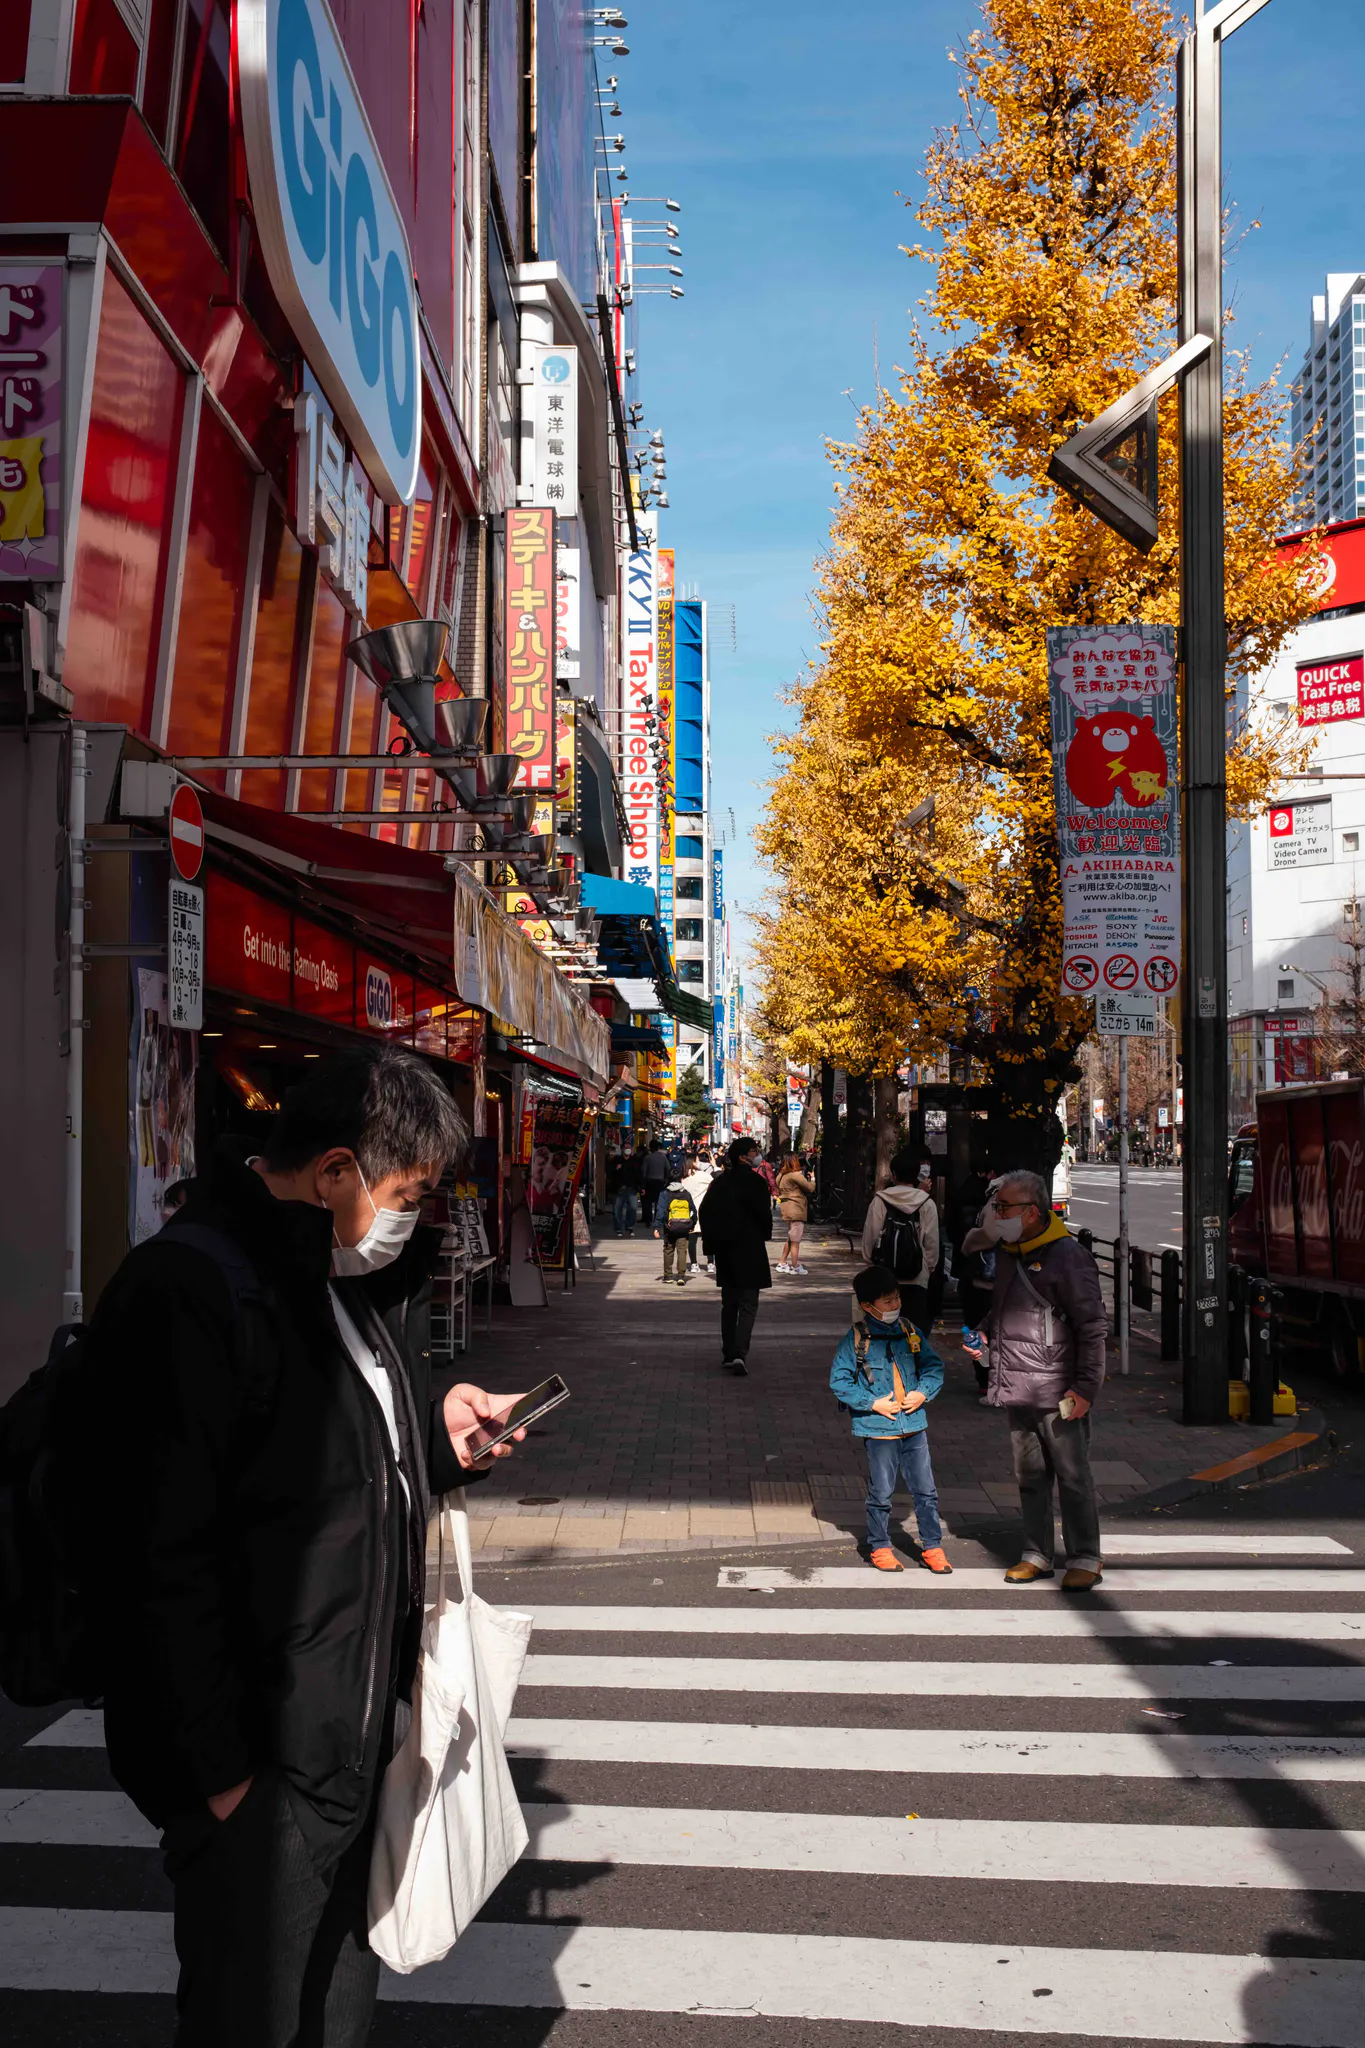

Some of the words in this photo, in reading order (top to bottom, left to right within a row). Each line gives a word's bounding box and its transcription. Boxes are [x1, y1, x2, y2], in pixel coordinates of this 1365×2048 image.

[1072, 648, 1157, 663] みんなで協力
[1072, 664, 1159, 679] 安全・安心
[1300, 664, 1350, 687] QUICK
[1074, 680, 1159, 694] 元気なアキバ
[1300, 686, 1326, 700] Tax
[1328, 680, 1362, 697] Free
[1303, 697, 1361, 721] 快速免税
[1295, 805, 1315, 815] カメラ
[1066, 812, 1169, 831] Welcome!
[1295, 816, 1315, 825] テレビ
[1295, 824, 1330, 835] ビデオカメラ
[1273, 840, 1302, 849] Camera
[1307, 837, 1317, 845] TV
[1274, 850, 1297, 858] Video
[1298, 846, 1328, 856] Camera
[1082, 859, 1175, 872] AKIHABARA
[1274, 858, 1297, 867] Drone
[1068, 881, 1172, 893] ご利用は安心の加盟店へ!
[1082, 891, 1158, 903] www.akiba.or.jp
[1072, 914, 1091, 922] ASK
[1151, 915, 1168, 923] JVC
[1064, 924, 1098, 932] SHARP
[1064, 933, 1098, 941] TOSHIBA
[1105, 932, 1136, 940] DENON
[1144, 933, 1175, 941] Panasonic
[1064, 942, 1099, 950] HITACHI
[243, 925, 259, 961] Get
[261, 932, 277, 967] into
[278, 941, 291, 973] the
[293, 948, 320, 992] Gaming
[320, 960, 339, 992] Oasis
[1100, 998, 1122, 1013] を除く
[1100, 1016, 1131, 1030] ここから
[1136, 1017, 1154, 1032] 14m
[1159, 1109, 1166, 1117] P
